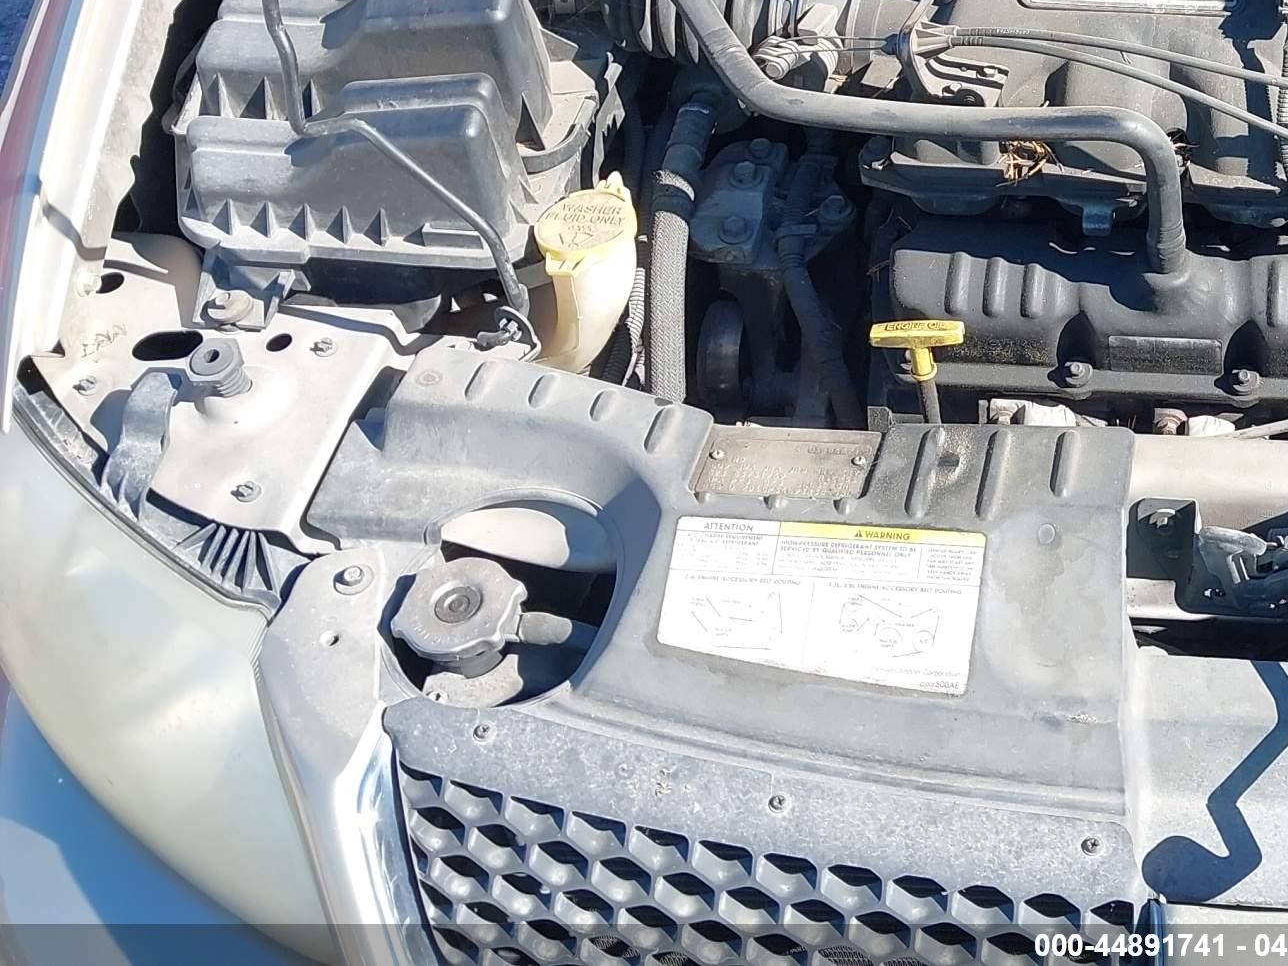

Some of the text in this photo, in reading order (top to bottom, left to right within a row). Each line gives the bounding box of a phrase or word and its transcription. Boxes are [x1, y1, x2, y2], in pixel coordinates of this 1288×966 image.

[561, 203, 623, 216] WASHER
[545, 211, 626, 227] FLUID ONLY
[884, 322, 945, 332] ENGINE OIL
[704, 521, 754, 533] ATTENTION
[864, 530, 911, 542] WARNING
